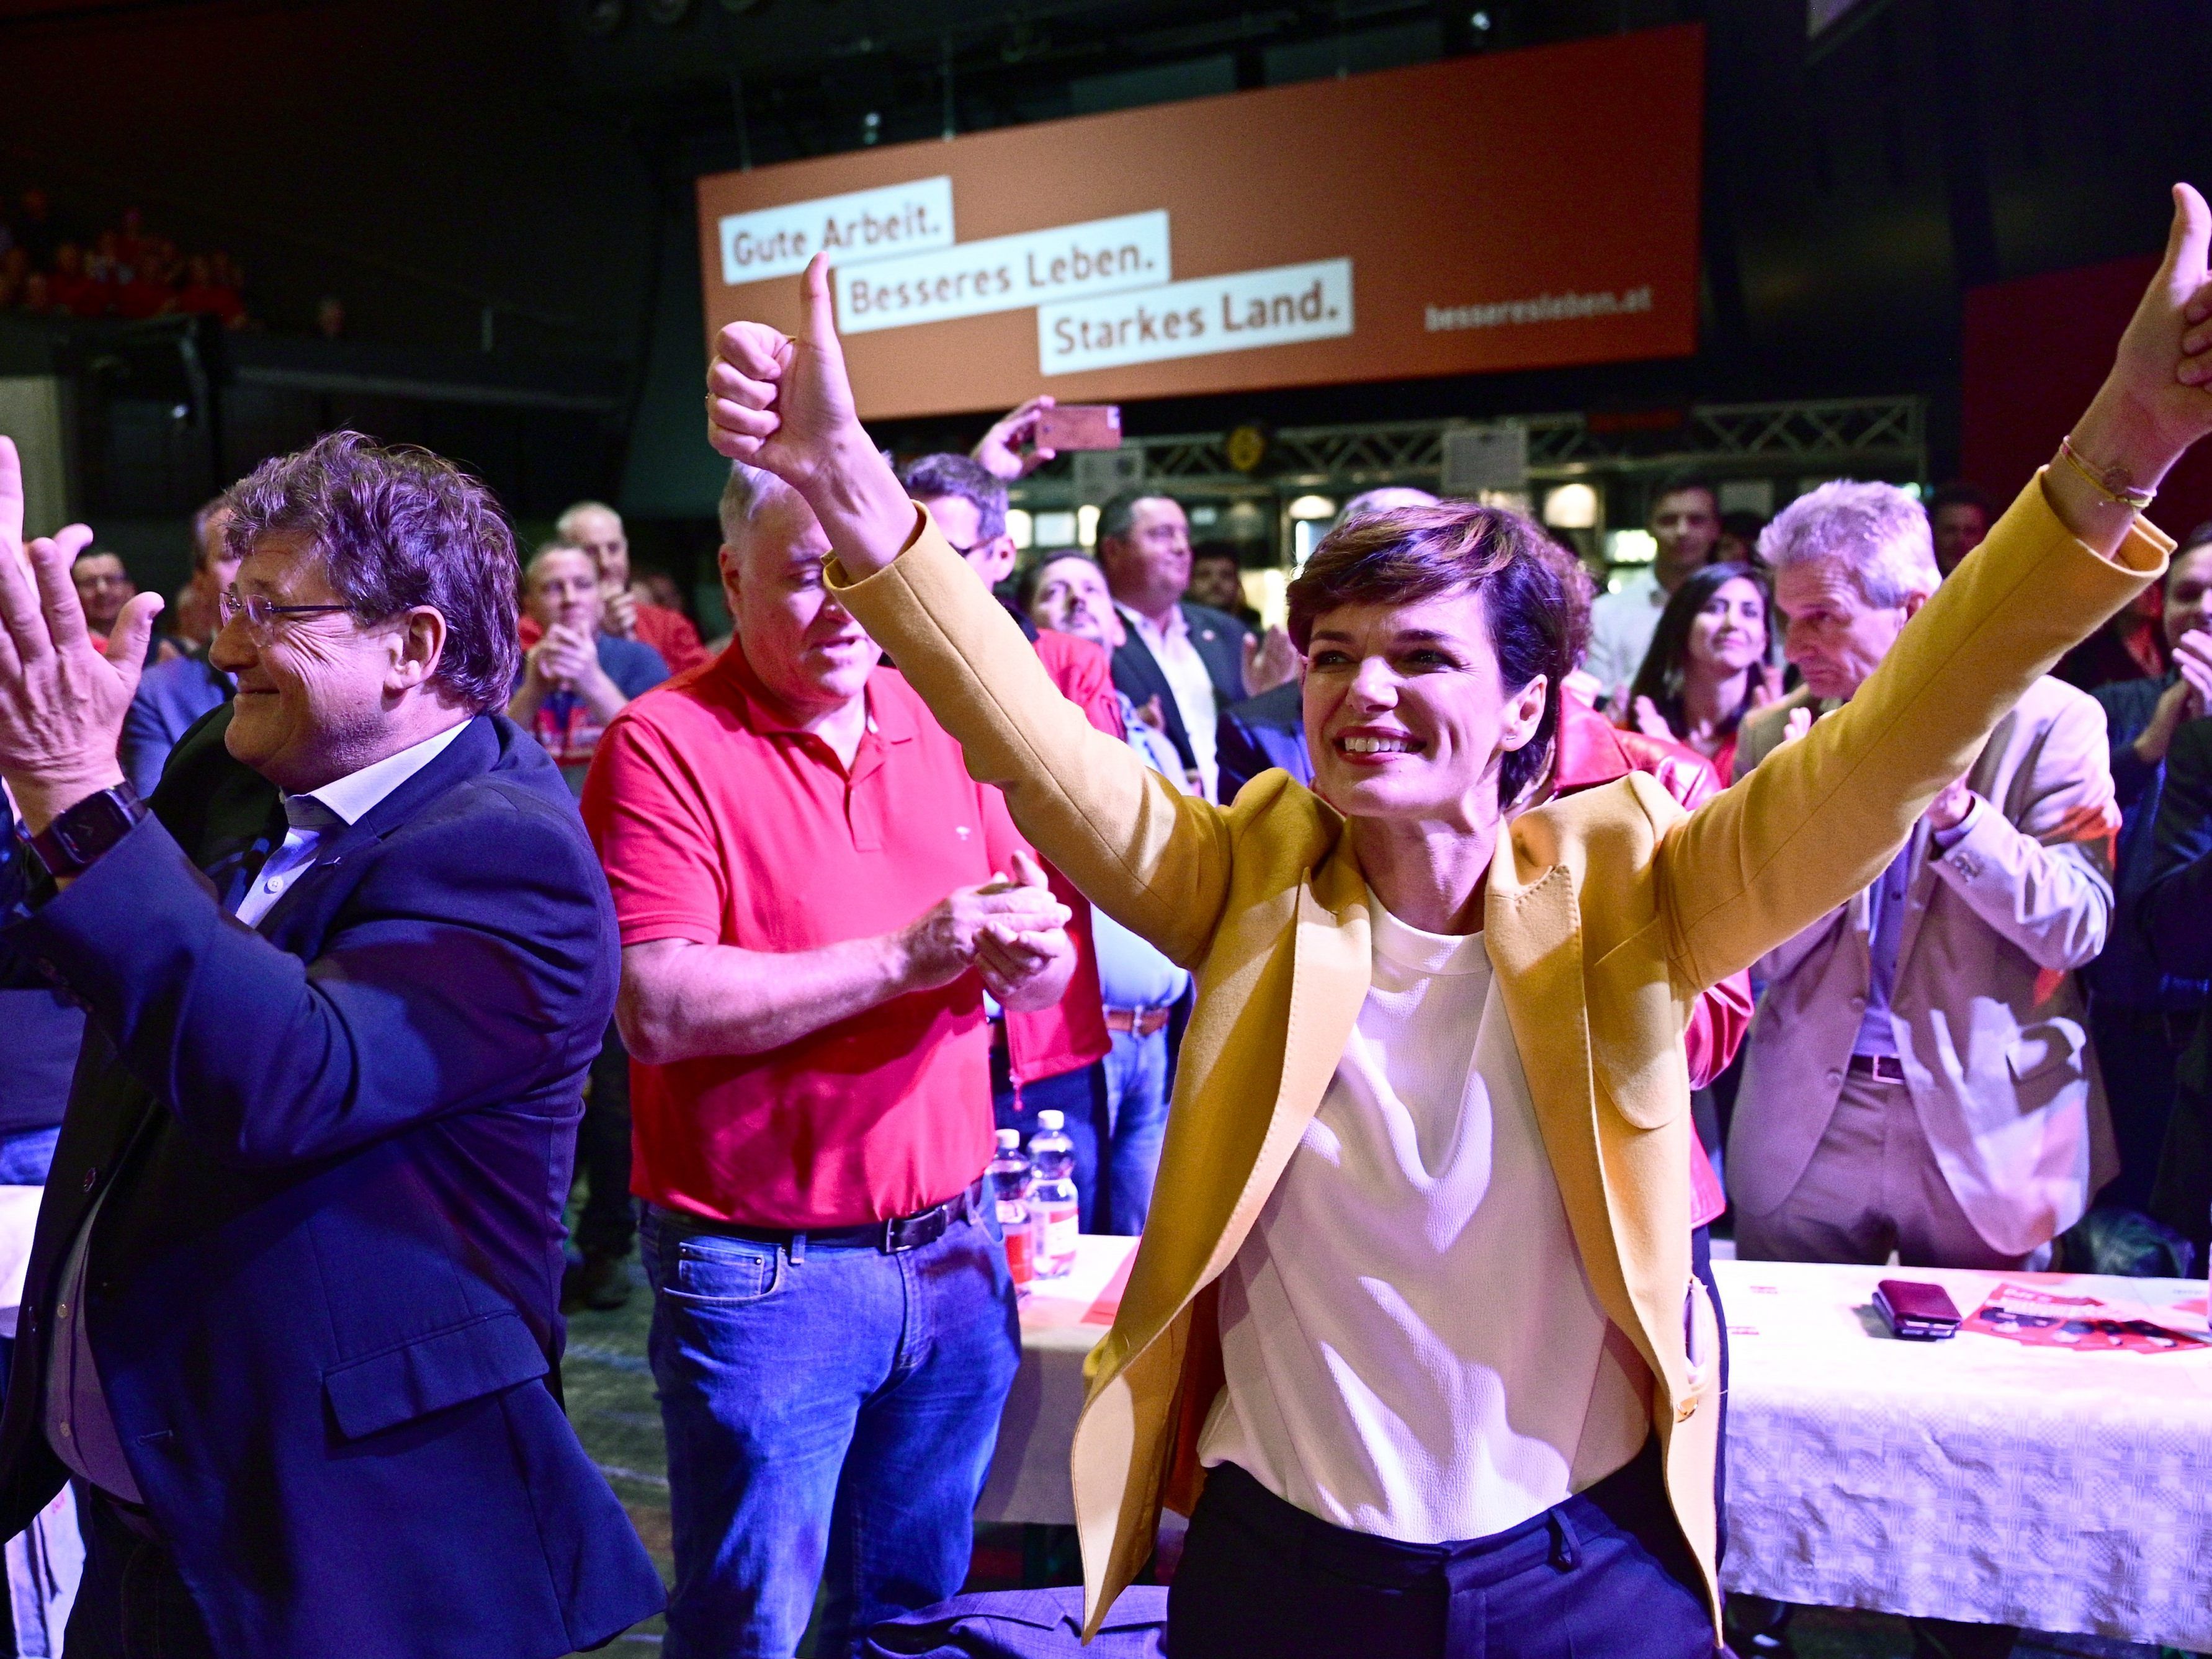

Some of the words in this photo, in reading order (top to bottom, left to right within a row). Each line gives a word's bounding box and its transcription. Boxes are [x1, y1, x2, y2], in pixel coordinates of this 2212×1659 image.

[733, 230, 806, 266] Gute
[822, 202, 941, 249] Arbeit.
[850, 265, 1011, 315] Besseres
[1028, 242, 1155, 287] Leben.
[1425, 287, 1652, 331] besseresleben.at
[1054, 303, 1206, 356] Starkes
[1222, 279, 1338, 333] Land.
